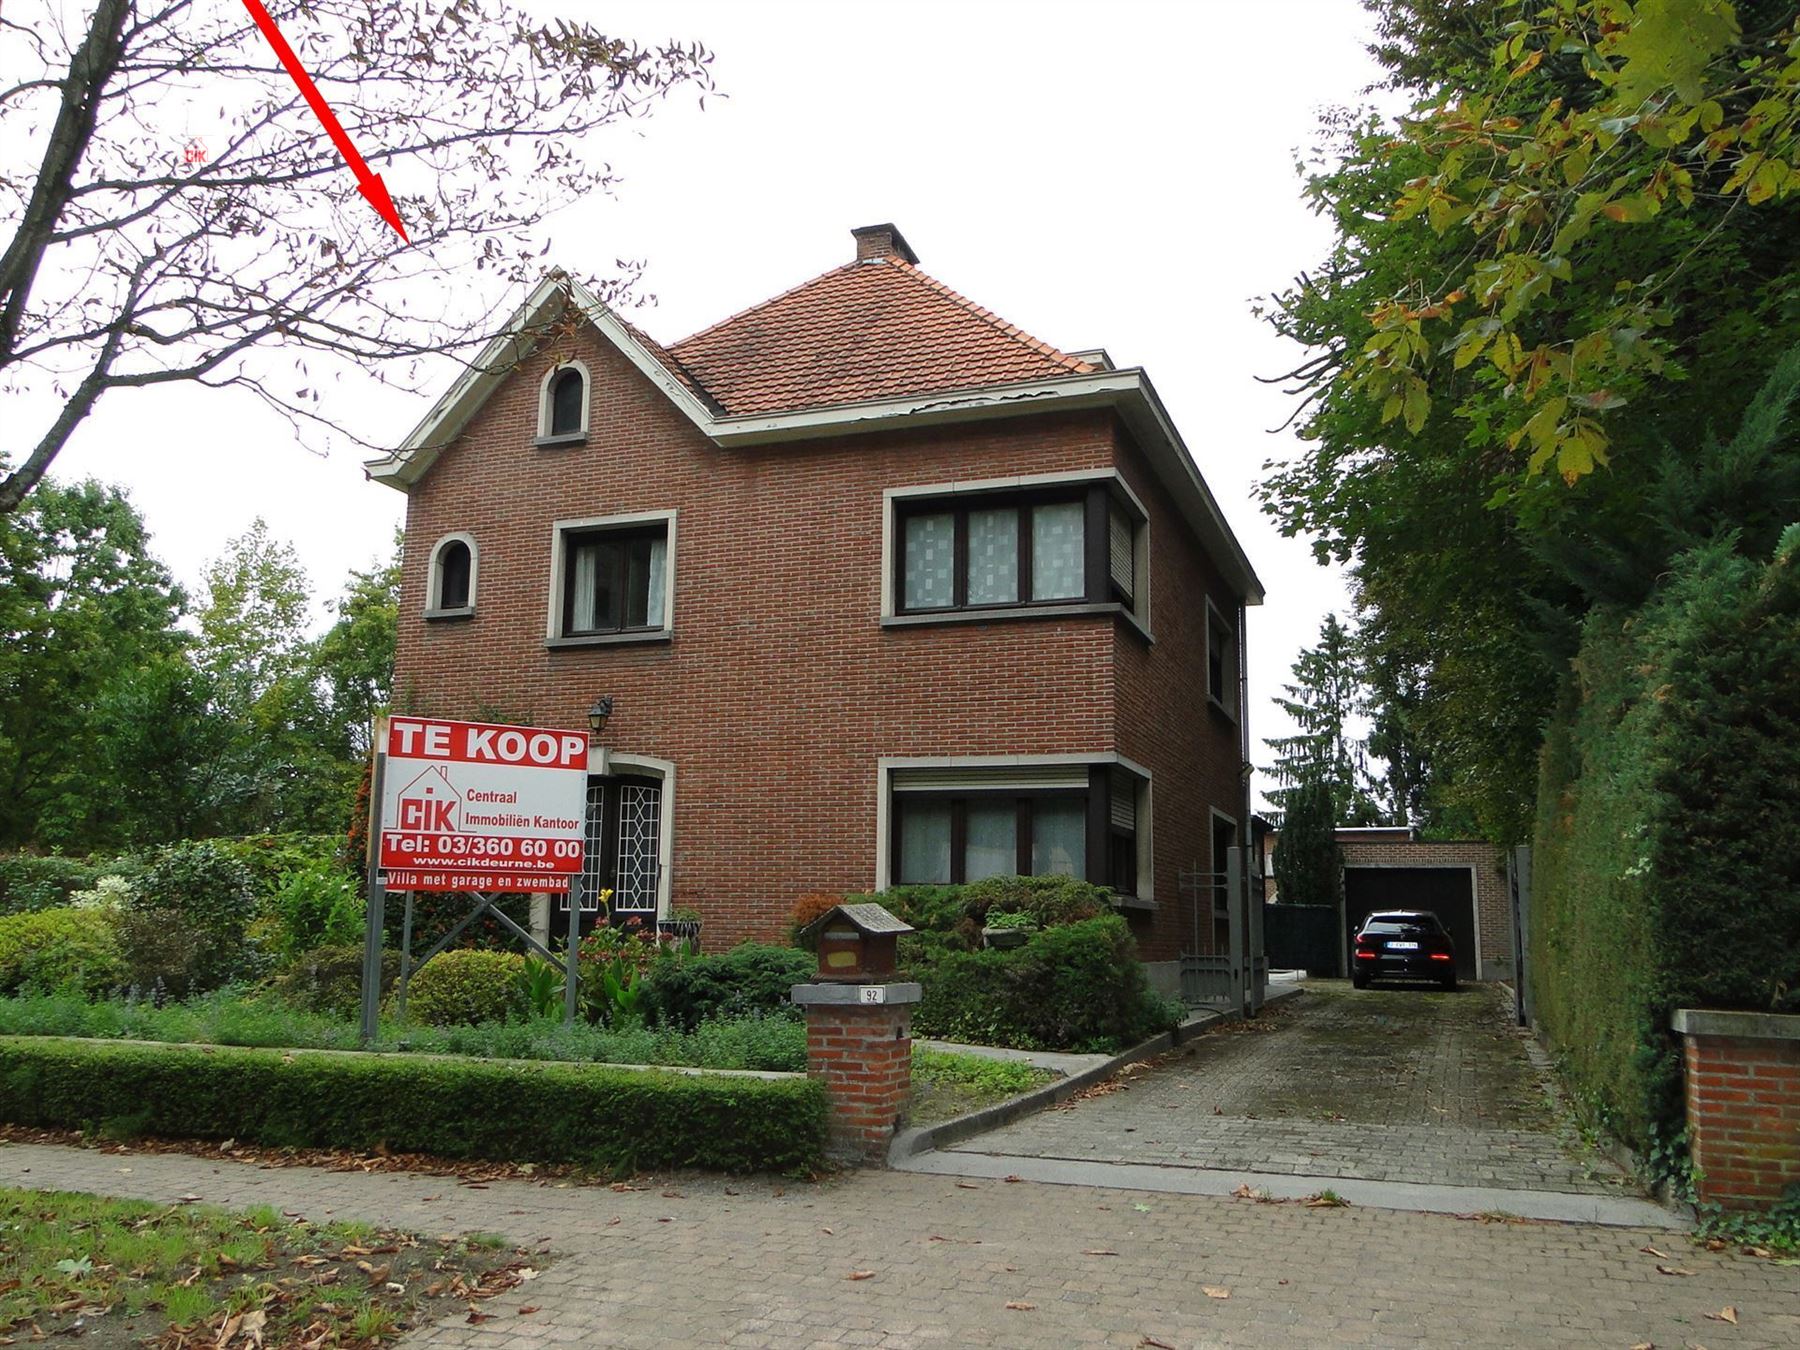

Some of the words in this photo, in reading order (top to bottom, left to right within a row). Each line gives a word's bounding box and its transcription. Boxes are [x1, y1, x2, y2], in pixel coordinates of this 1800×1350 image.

[394, 722, 451, 757] TE
[466, 728, 585, 765] KOOP
[467, 789, 517, 804] Centraal
[465, 812, 530, 828] Immobiliën
[533, 815, 579, 830] Kantoor
[387, 834, 430, 853] Tel:
[437, 836, 513, 856] 03/360
[520, 840, 548, 857] 60
[554, 841, 580, 858] 00
[413, 857, 555, 869] www.cikdeurne.be
[388, 872, 417, 885] Villa
[424, 873, 446, 886] met
[452, 875, 493, 888] garage
[498, 876, 512, 887] en
[517, 875, 568, 889] zwembad
[866, 990, 878, 1001] 92
